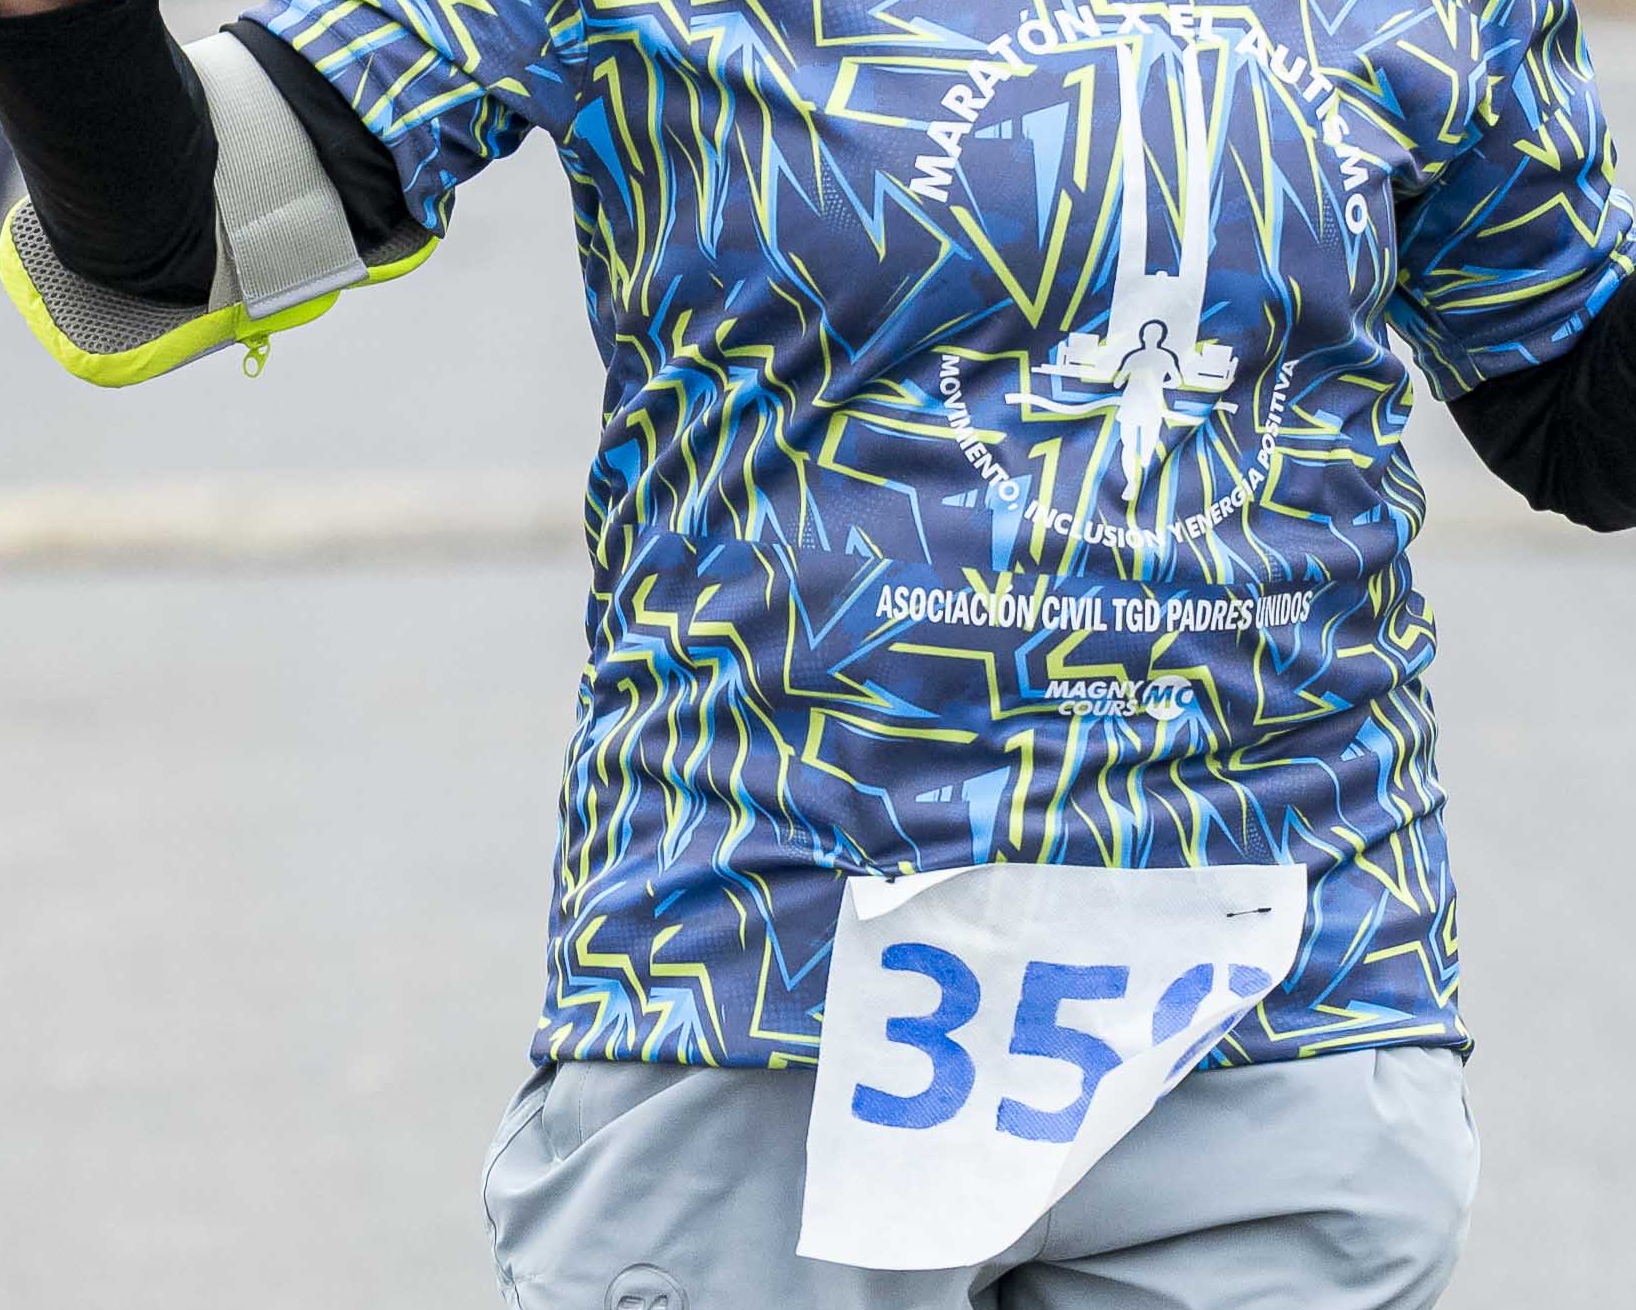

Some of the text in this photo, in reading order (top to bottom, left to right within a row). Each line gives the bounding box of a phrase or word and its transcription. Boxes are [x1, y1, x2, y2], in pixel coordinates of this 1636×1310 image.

[909, 3, 1369, 234] MARATÓN X EL AUTISMO
[940, 355, 1020, 510] MOVIMIENTO,
[1167, 524, 1186, 543] Y
[1257, 359, 1300, 470] POSITIVA
[875, 584, 1313, 632] ASOCIACIÓN CIVIL TGD PADRES UNIDOS
[1044, 680, 1145, 699] MAGNY
[1058, 700, 1139, 717] COURS
